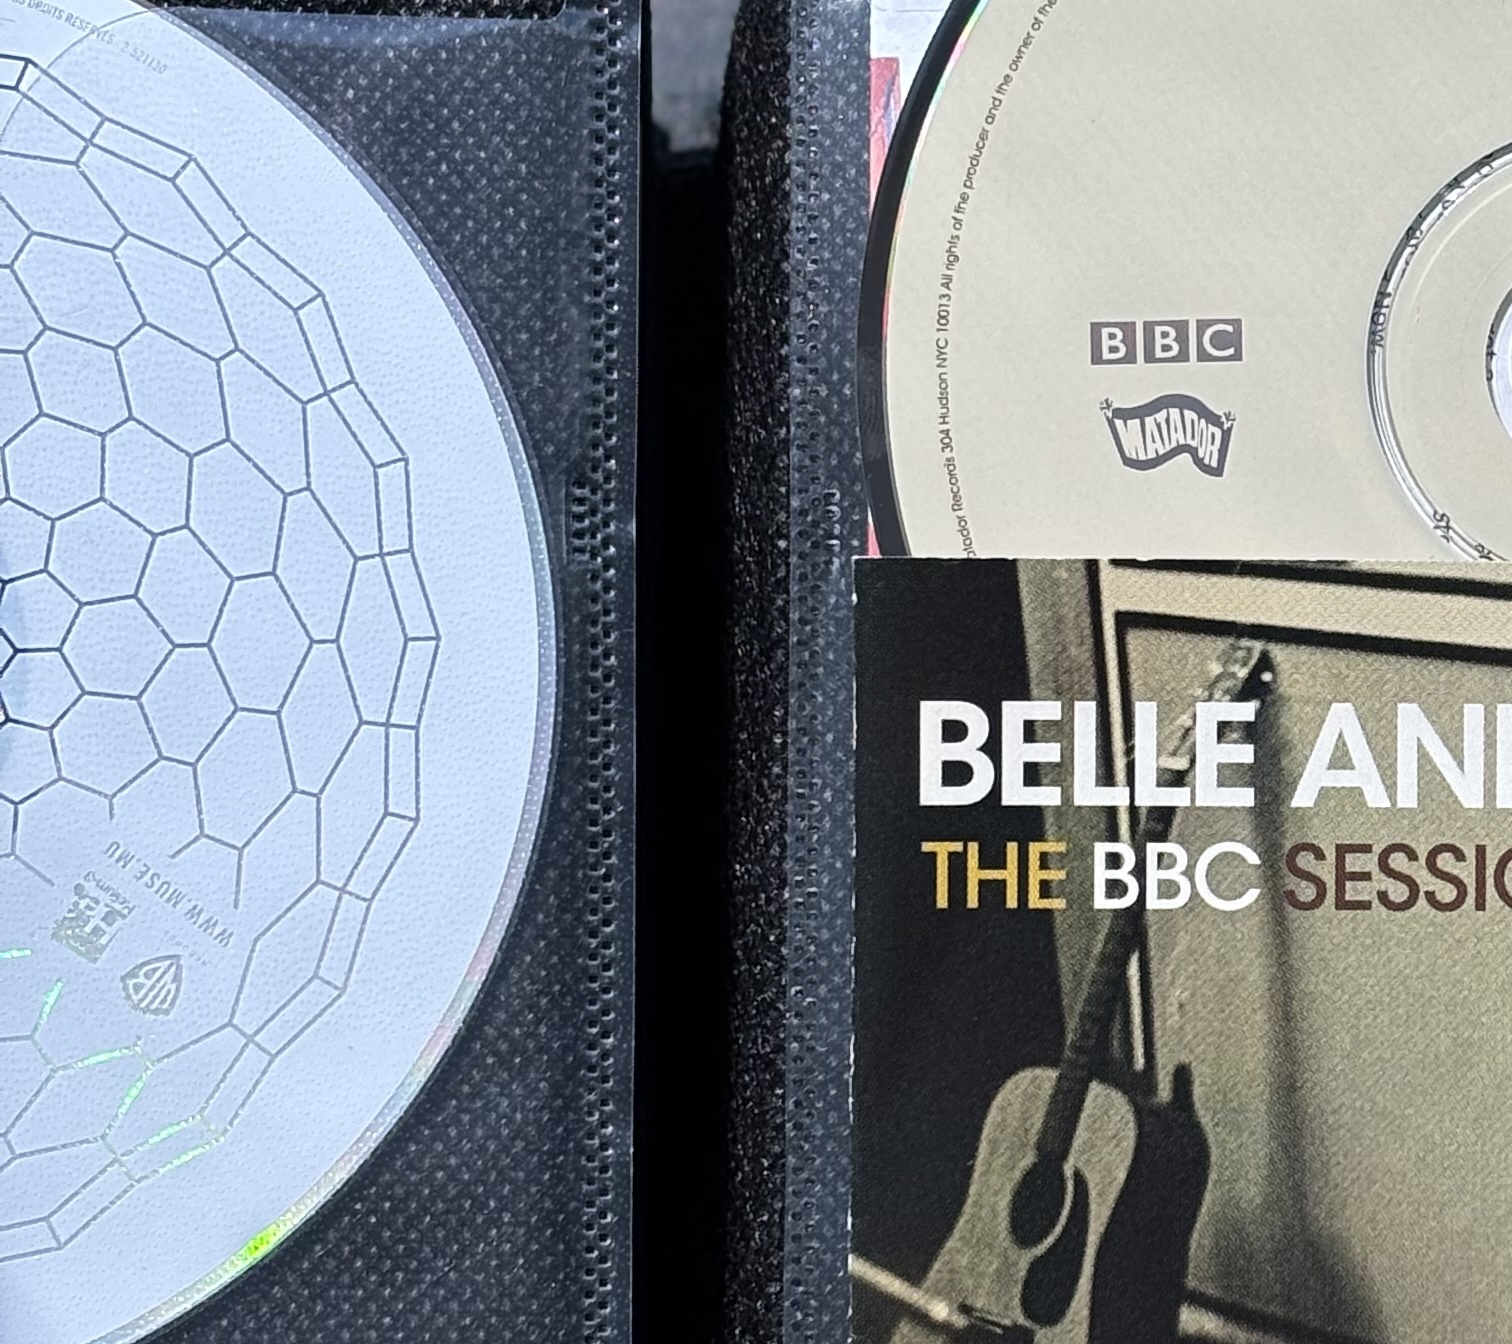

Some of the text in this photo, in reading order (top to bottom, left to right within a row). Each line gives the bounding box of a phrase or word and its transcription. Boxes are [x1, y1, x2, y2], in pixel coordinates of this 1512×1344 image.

[1030, 15, 1045, 32] of
[1008, 30, 1036, 73] owner
[993, 73, 1014, 96] the
[984, 95, 1003, 126] and
[962, 125, 990, 191] producer
[950, 215, 964, 232] of
[952, 191, 970, 215] the
[943, 233, 961, 272] rights
[939, 273, 954, 292] All
[935, 293, 952, 333] 10013
[934, 337, 949, 369] NYC
[1094, 319, 1240, 363] BBC
[936, 371, 951, 426] Hudson
[938, 427, 954, 454] 304
[1112, 406, 1222, 470] MATADOR
[942, 455, 964, 513] Records
[954, 514, 978, 558] atador
[918, 699, 1257, 808] BELLE
[105, 839, 236, 948] WWW.MUSE.MU
[920, 840, 1069, 911] THE
[1091, 840, 1262, 912] BBC
